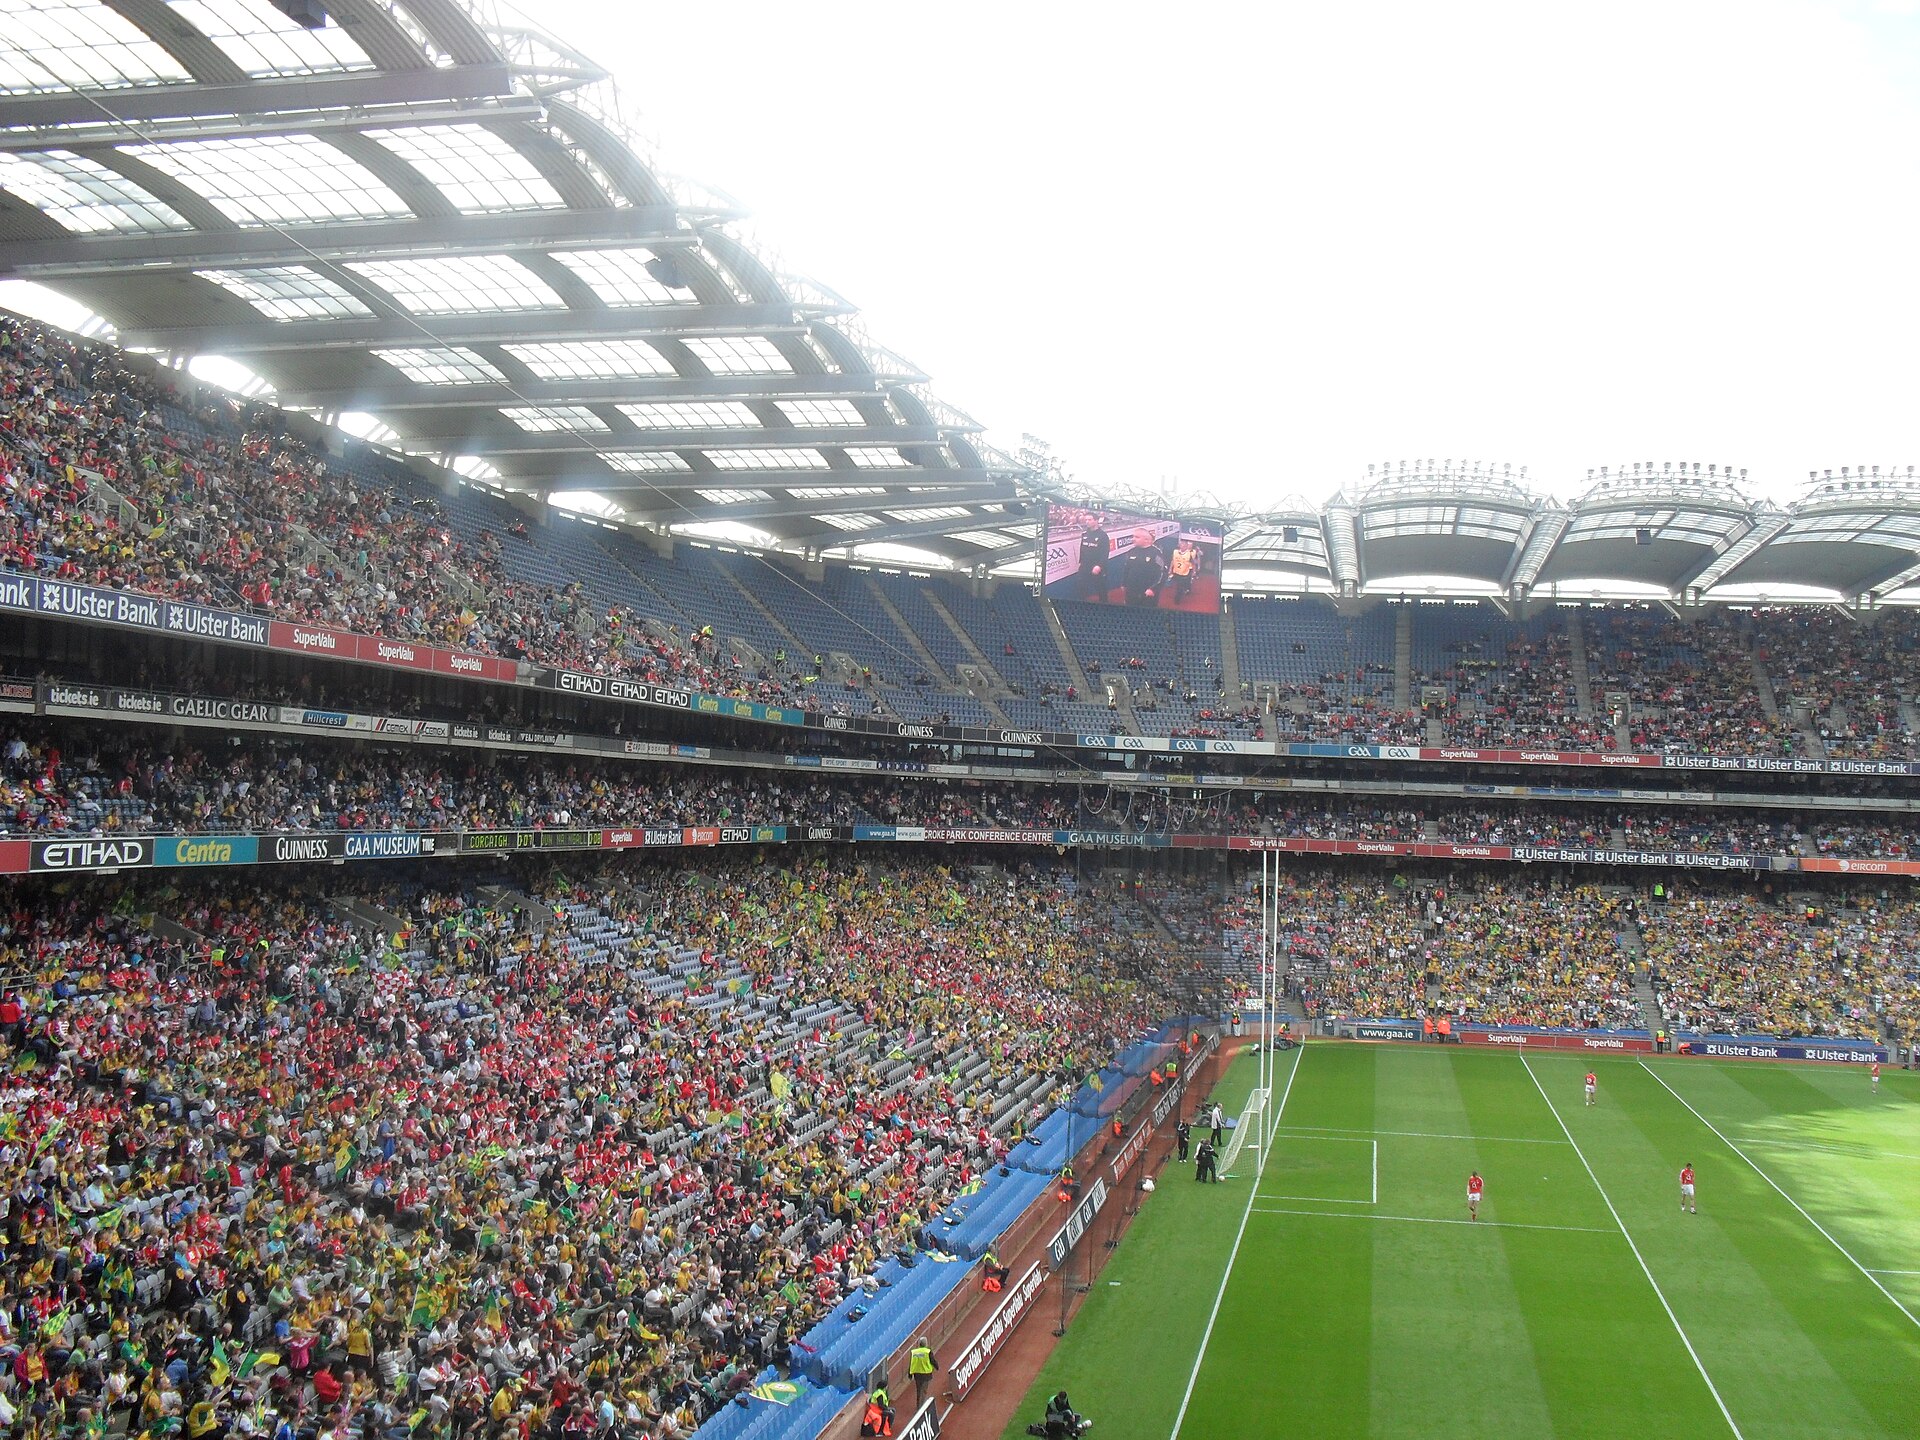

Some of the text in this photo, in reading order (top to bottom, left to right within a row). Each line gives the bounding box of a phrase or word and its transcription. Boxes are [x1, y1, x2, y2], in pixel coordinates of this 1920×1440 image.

[63, 588, 157, 626] Ulster Bank
[185, 608, 265, 643] Ulster Bank
[293, 629, 335, 648] SuperValu
[378, 642, 414, 661] SuperValu
[450, 654, 482, 672] SuperValu
[561, 673, 602, 693] ETIHAD
[611, 681, 648, 700] ETIHAD
[655, 689, 688, 706] ETIHAD
[698, 696, 718, 712] Centra
[174, 698, 228, 718] GAELIC
[230, 703, 268, 721] GEAR
[734, 701, 752, 716] Centra
[765, 707, 782, 721] Centra
[307, 713, 342, 725] Hillcrest
[823, 715, 847, 730] GUINNESS
[898, 722, 934, 737] GUINNESS
[1000, 730, 1042, 744] GUINNESS
[1440, 750, 1478, 760] SuperValu
[1520, 752, 1558, 762] SuperValu
[1601, 755, 1639, 765] SuperValu
[1676, 757, 1740, 768] Ulster Bank
[1758, 759, 1822, 771] Ulster Bank
[1842, 762, 1907, 774] Ulster Bank
[610, 831, 632, 845] SuperValu
[651, 831, 681, 844] Ulster Bank
[722, 830, 748, 841] ETIHAD
[757, 829, 773, 840] Centra
[924, 829, 1052, 842] CROKE PARK CONFERENCE CENTRE
[1070, 833, 1143, 845] GAA MUSEUM
[346, 836, 420, 856] GAA MUSEUM
[470, 835, 507, 848] CORCAIGH
[1358, 843, 1394, 852] SuperValu
[43, 841, 143, 867] ETIHAD
[176, 839, 231, 863] Centra
[275, 837, 328, 860] GUINNESS
[1453, 847, 1490, 856] SuperValu
[1525, 850, 1587, 861] Ulster Bank
[1606, 852, 1668, 864] Ulster Bank
[1686, 856, 1749, 866] Ulster Bank
[1362, 1029, 1413, 1039] www.gaa.ie
[1488, 1034, 1527, 1045] SuperValu
[1584, 1038, 1623, 1049] SuperValu
[1717, 1044, 1778, 1058] Ulster Bank
[1816, 1049, 1878, 1062] Ulster Bank
[956, 1267, 1043, 1389] SuperValu SuperValu SuperValu SuperValu
